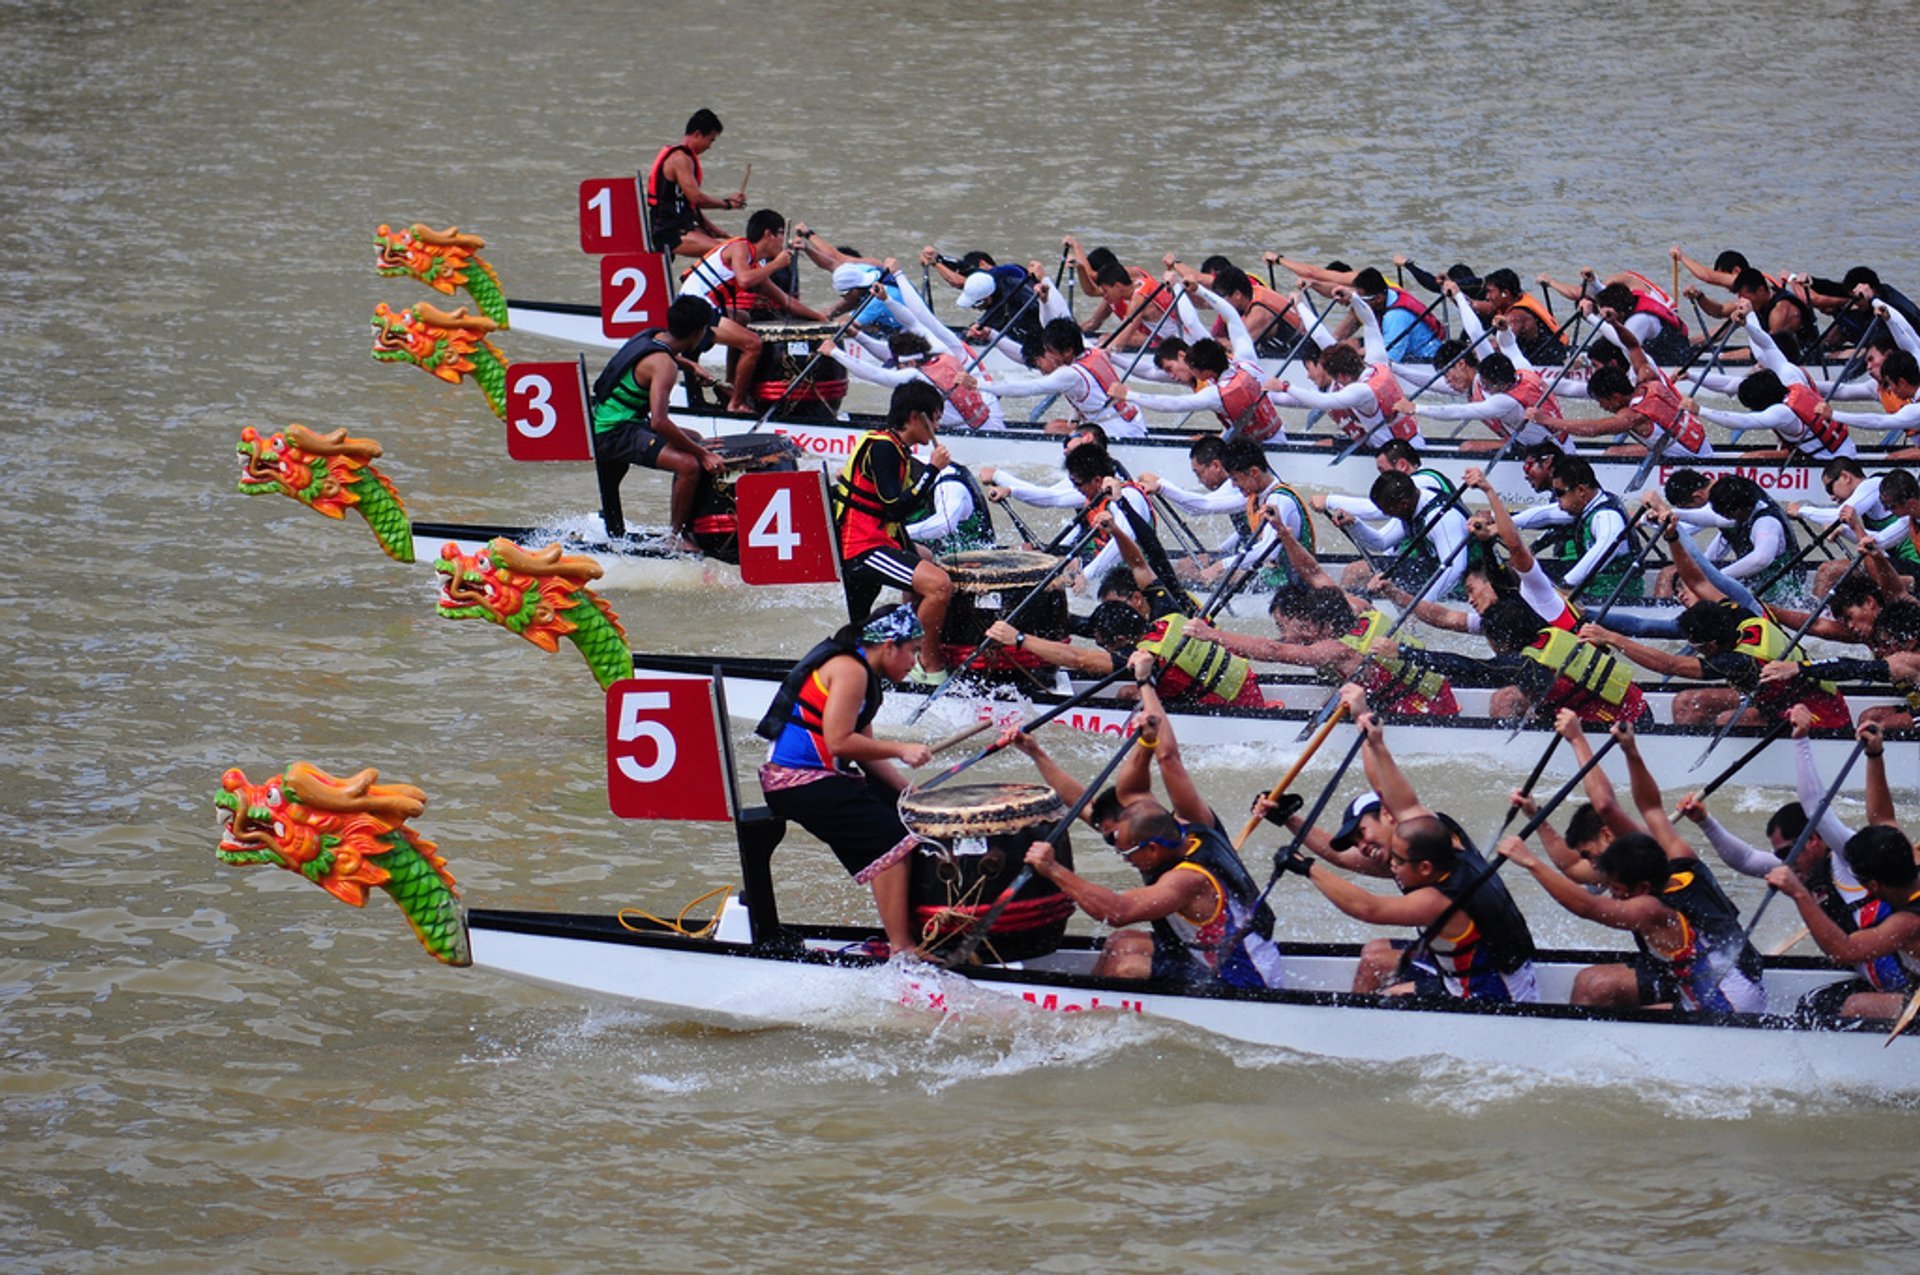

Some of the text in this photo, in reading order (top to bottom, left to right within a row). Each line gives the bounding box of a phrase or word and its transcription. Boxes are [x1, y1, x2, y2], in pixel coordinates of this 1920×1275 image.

[587, 187, 613, 237] 1
[610, 267, 648, 324] 2
[513, 374, 557, 438] 3
[748, 488, 801, 561] 4
[616, 691, 677, 783] 5
